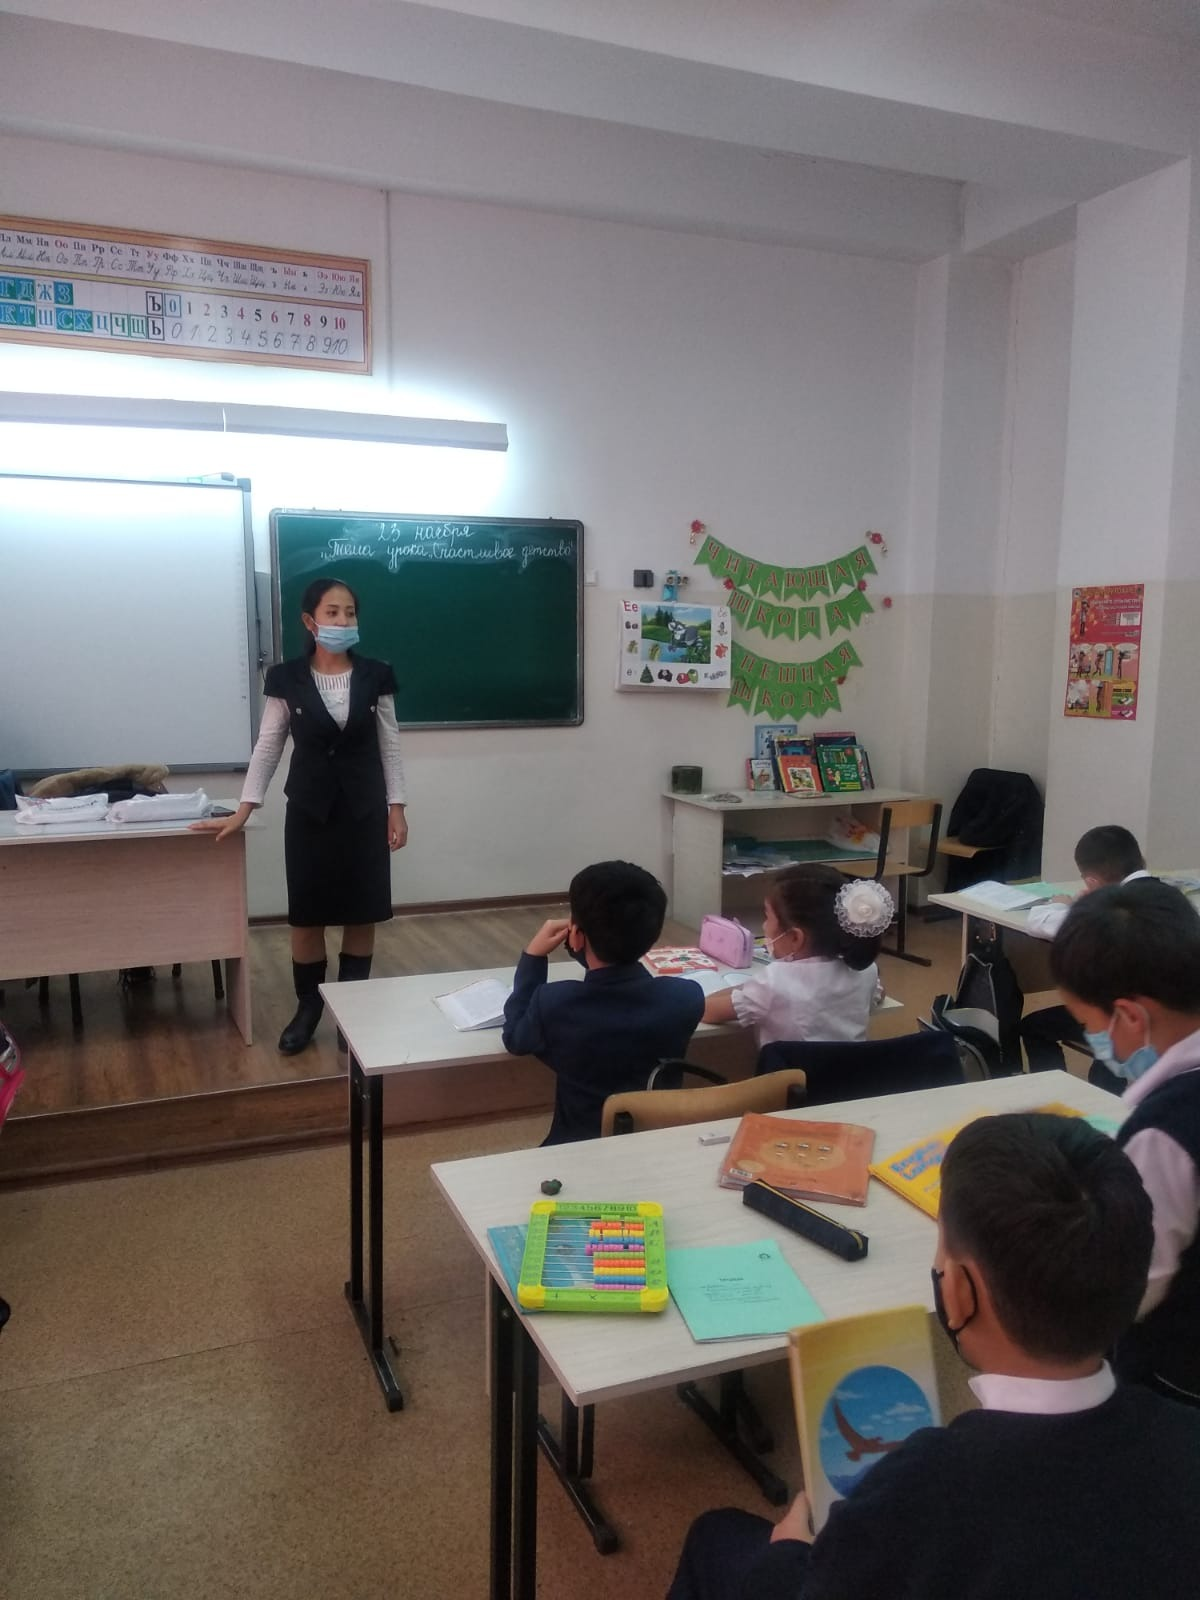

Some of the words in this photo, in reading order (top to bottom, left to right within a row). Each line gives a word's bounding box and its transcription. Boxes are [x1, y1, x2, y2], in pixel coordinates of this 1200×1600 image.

[204, 304, 210, 316] 2
[221, 305, 228, 318] 3
[237, 307, 244, 319] 4
[255, 309, 262, 321] 5
[271, 311, 278, 323] 6
[288, 312, 295, 325] 7
[304, 314, 311, 326] 8
[320, 316, 327, 327] 9
[334, 317, 346, 330] 10
[378, 522, 401, 542] 23
[733, 681, 834, 707] ШКОЛА
